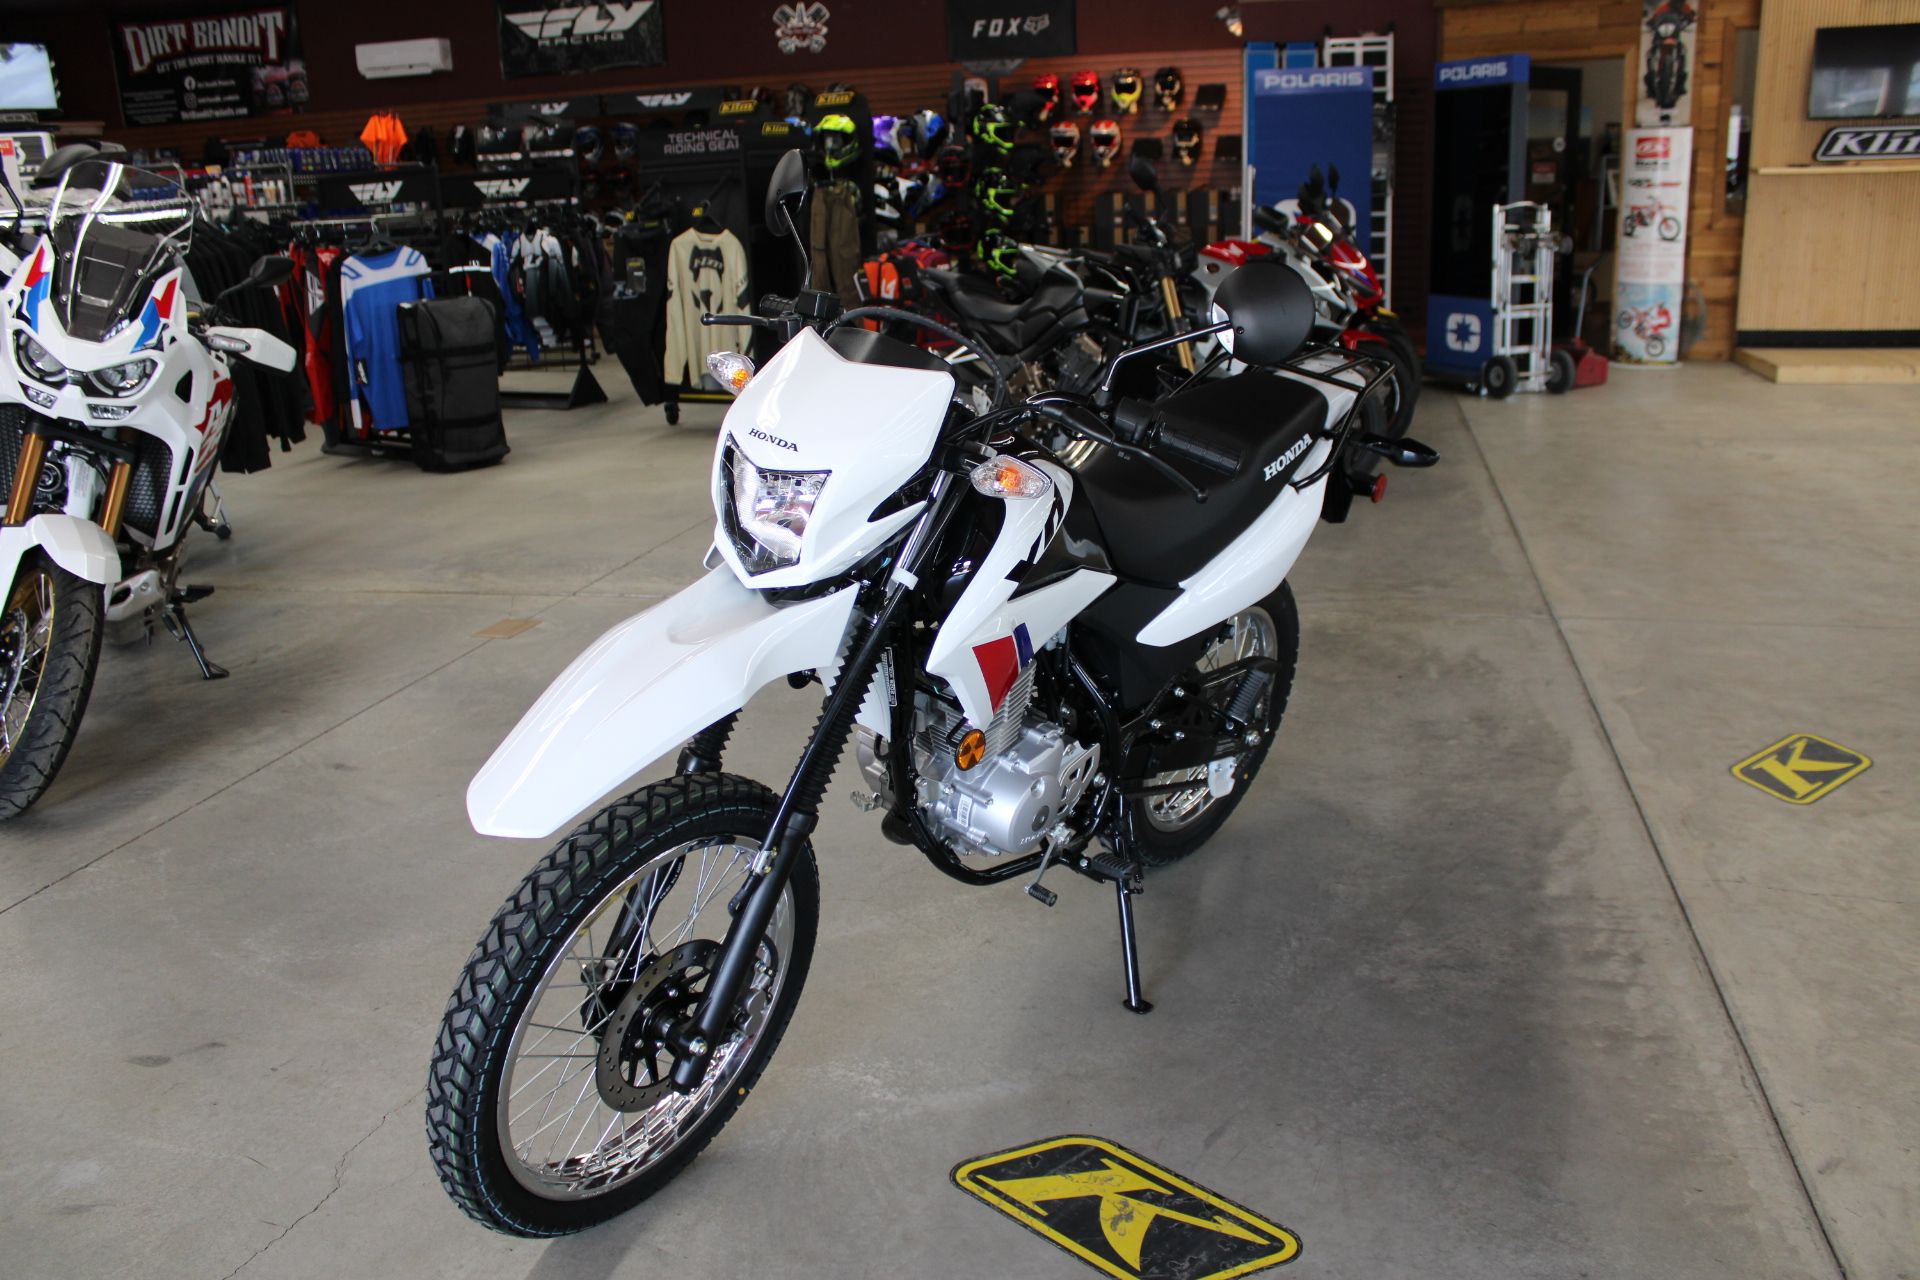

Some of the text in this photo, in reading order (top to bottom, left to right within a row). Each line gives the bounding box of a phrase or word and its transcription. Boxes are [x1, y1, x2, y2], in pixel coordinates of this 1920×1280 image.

[504, 0, 655, 39] FLY
[972, 17, 1021, 38] FOX
[122, 11, 285, 73] DIRT BANDIT
[537, 33, 625, 47] RACING
[1264, 71, 1363, 89] POLARIS
[1439, 61, 1508, 83] POLARIS
[636, 92, 692, 107] FLY
[667, 129, 738, 144] TECHNICAL
[664, 141, 705, 154] RIDING
[348, 180, 403, 201] FLY
[473, 177, 530, 197] FLY
[748, 428, 799, 452] HONDA
[1263, 433, 1313, 482] HONDA
